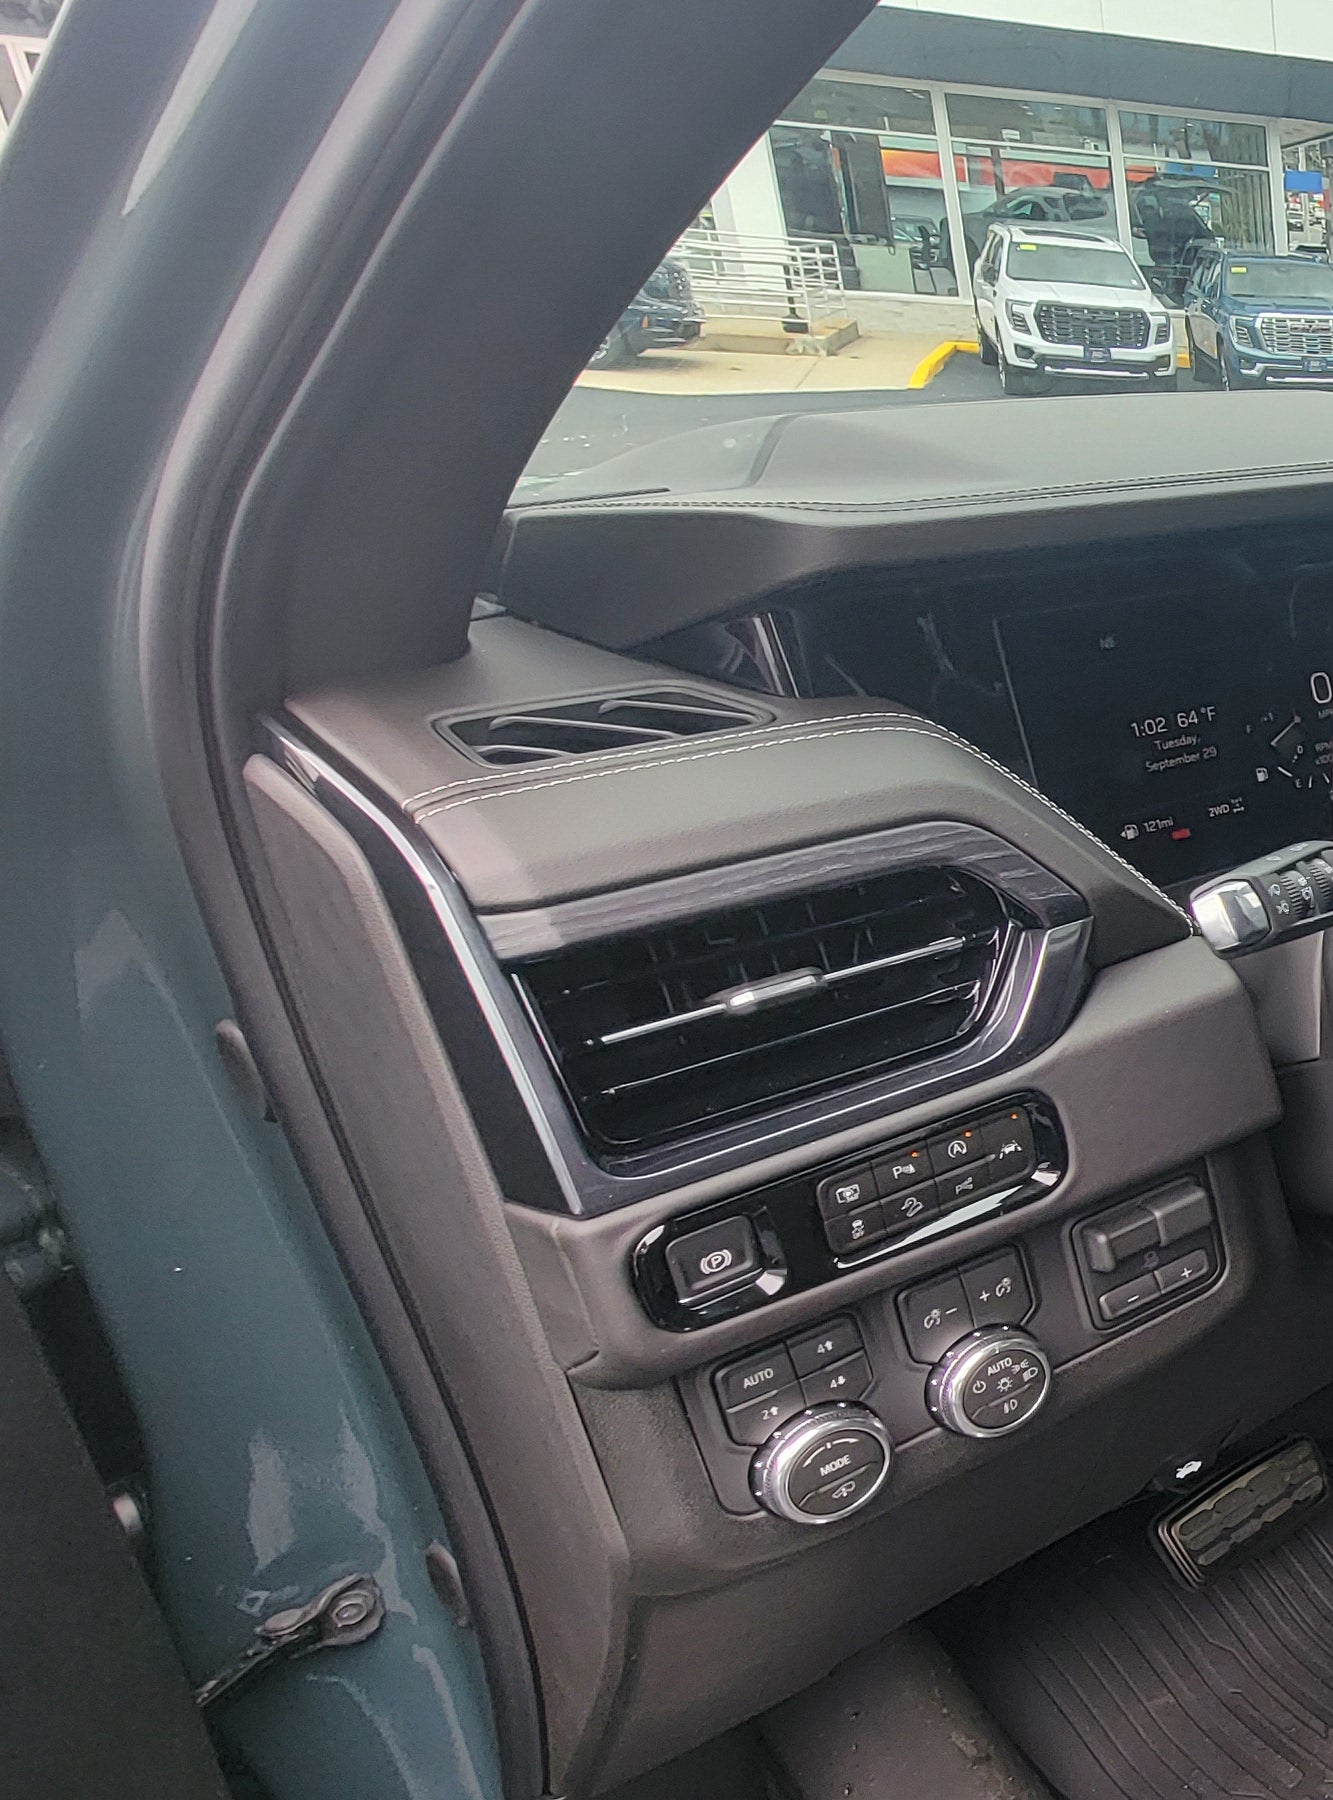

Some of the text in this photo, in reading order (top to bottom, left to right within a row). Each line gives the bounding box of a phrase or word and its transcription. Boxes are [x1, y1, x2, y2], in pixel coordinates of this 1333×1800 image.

[1310, 672, 1332, 704] 0
[1131, 717, 1169, 737] 1:02
[1145, 746, 1218, 773] September 29
[1208, 803, 1230, 817] 2WD
[1143, 816, 1174, 834] 121mi
[986, 1357, 1014, 1377] AUTO
[742, 1367, 774, 1389] AUTO
[819, 1453, 852, 1477] MODE
